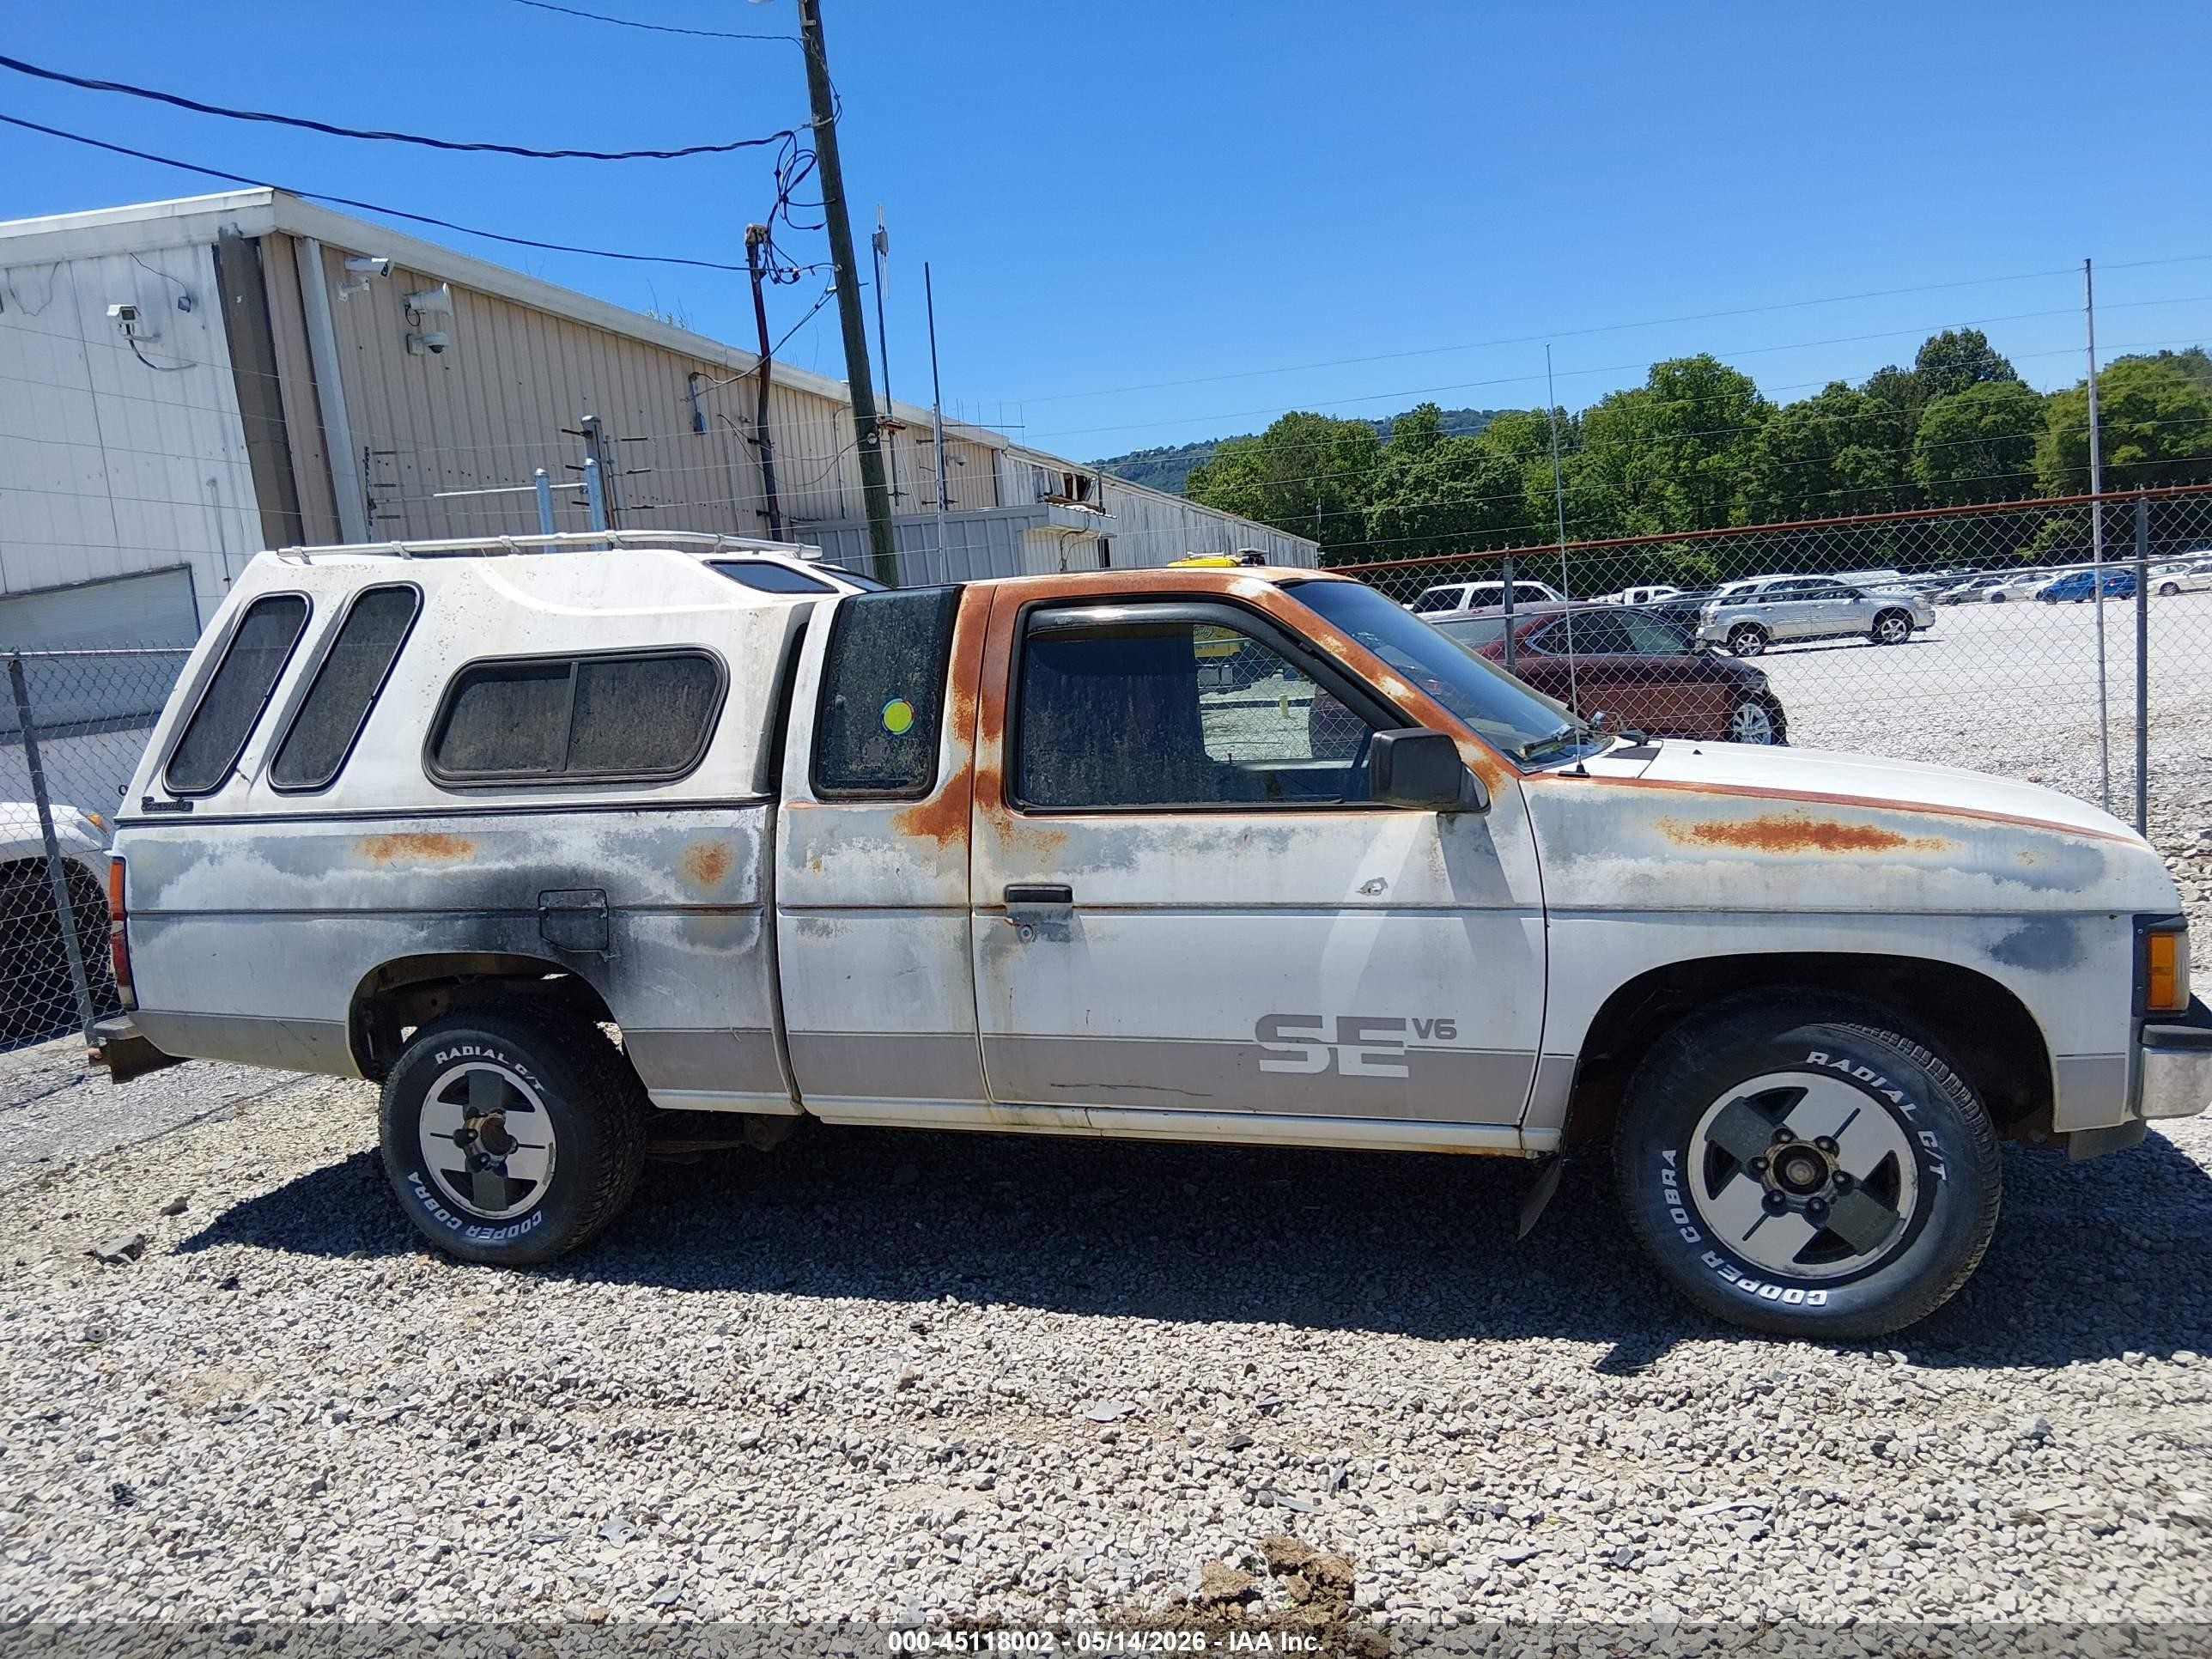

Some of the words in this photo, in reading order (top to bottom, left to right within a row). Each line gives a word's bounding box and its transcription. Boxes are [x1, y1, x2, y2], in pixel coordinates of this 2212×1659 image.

[434, 1046, 509, 1065] RADIAL
[515, 1063, 545, 1091] G/T
[1255, 1013, 1409, 1078] SE
[1412, 1018, 1457, 1040] V6
[1806, 1051, 1917, 1121] RADIAL
[1917, 1131, 1947, 1181] G/T
[407, 1171, 463, 1231] COBRA
[465, 1210, 542, 1240] COOPER
[1662, 1150, 1702, 1243] COBRA
[1700, 1250, 1828, 1306] COOPER
